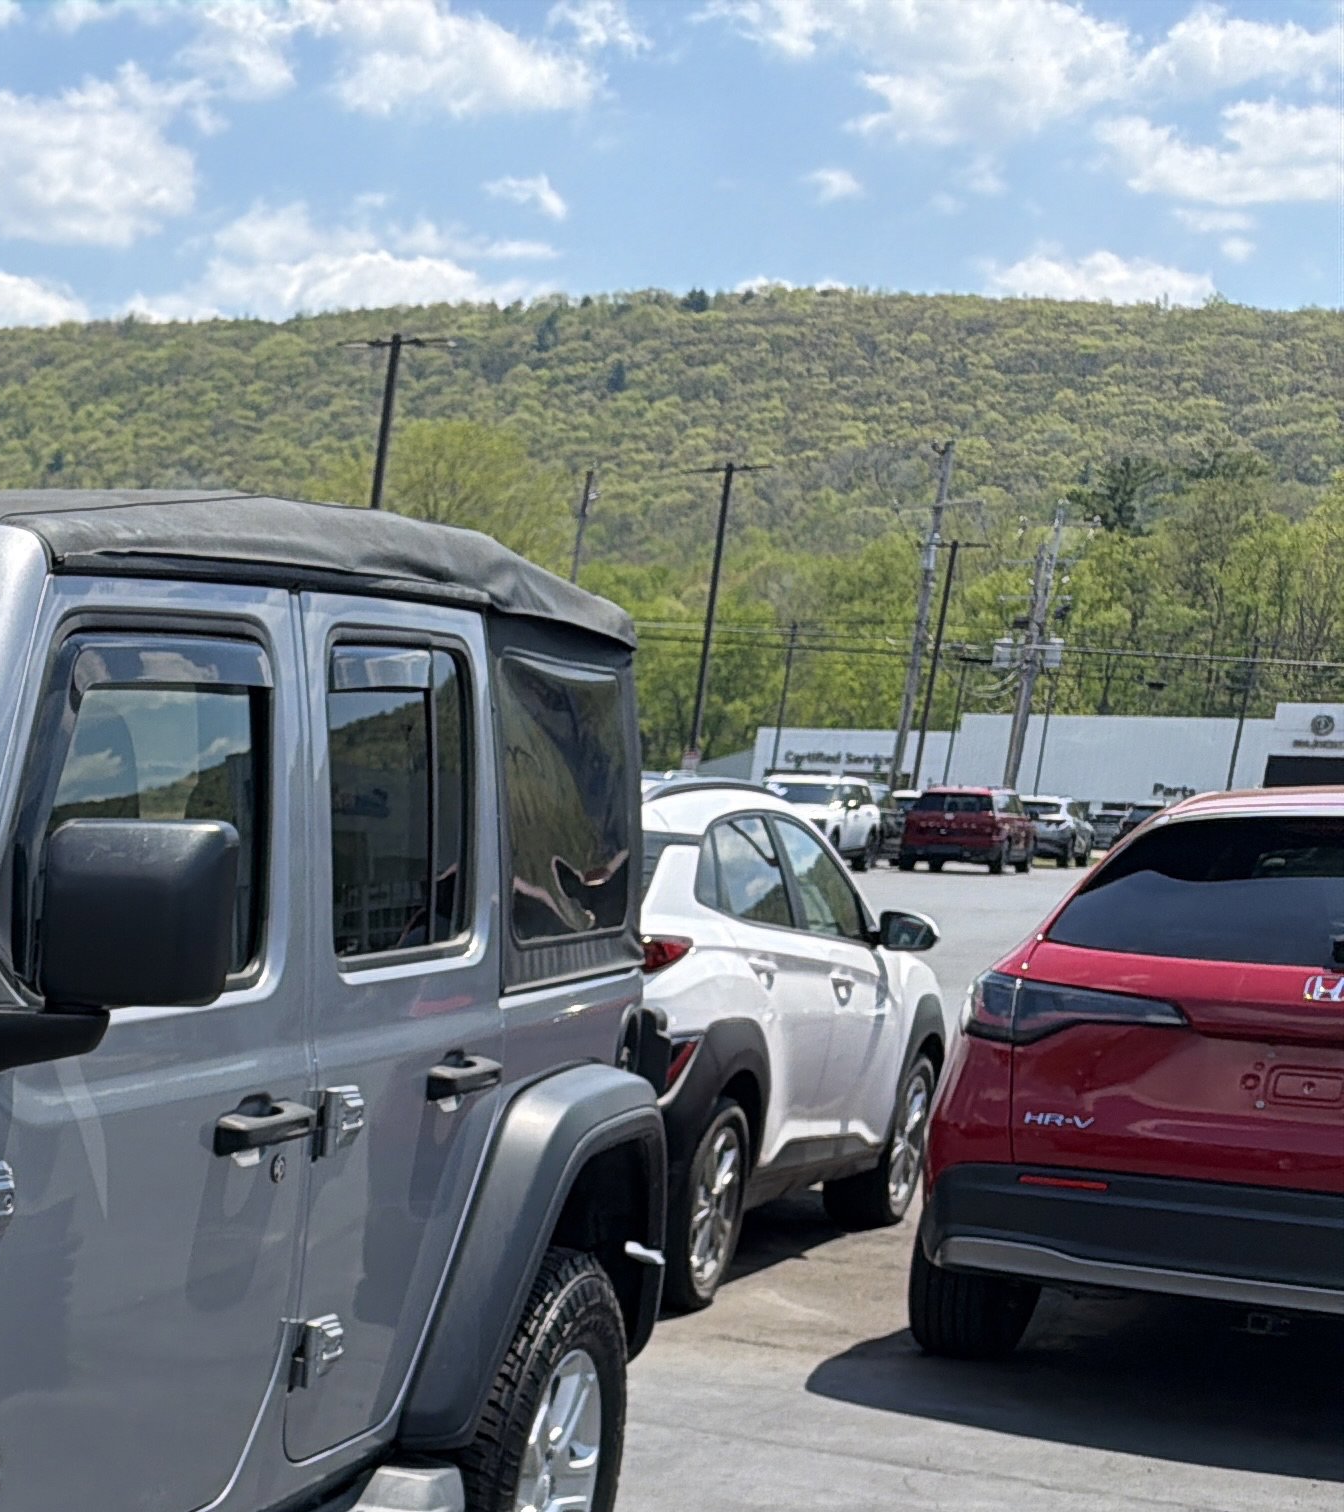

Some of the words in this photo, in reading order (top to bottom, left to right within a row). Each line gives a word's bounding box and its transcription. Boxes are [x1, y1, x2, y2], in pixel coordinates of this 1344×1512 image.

[785, 750, 841, 764] Certified
[1153, 782, 1195, 800] Parts
[1024, 1111, 1095, 1129] HR-V
